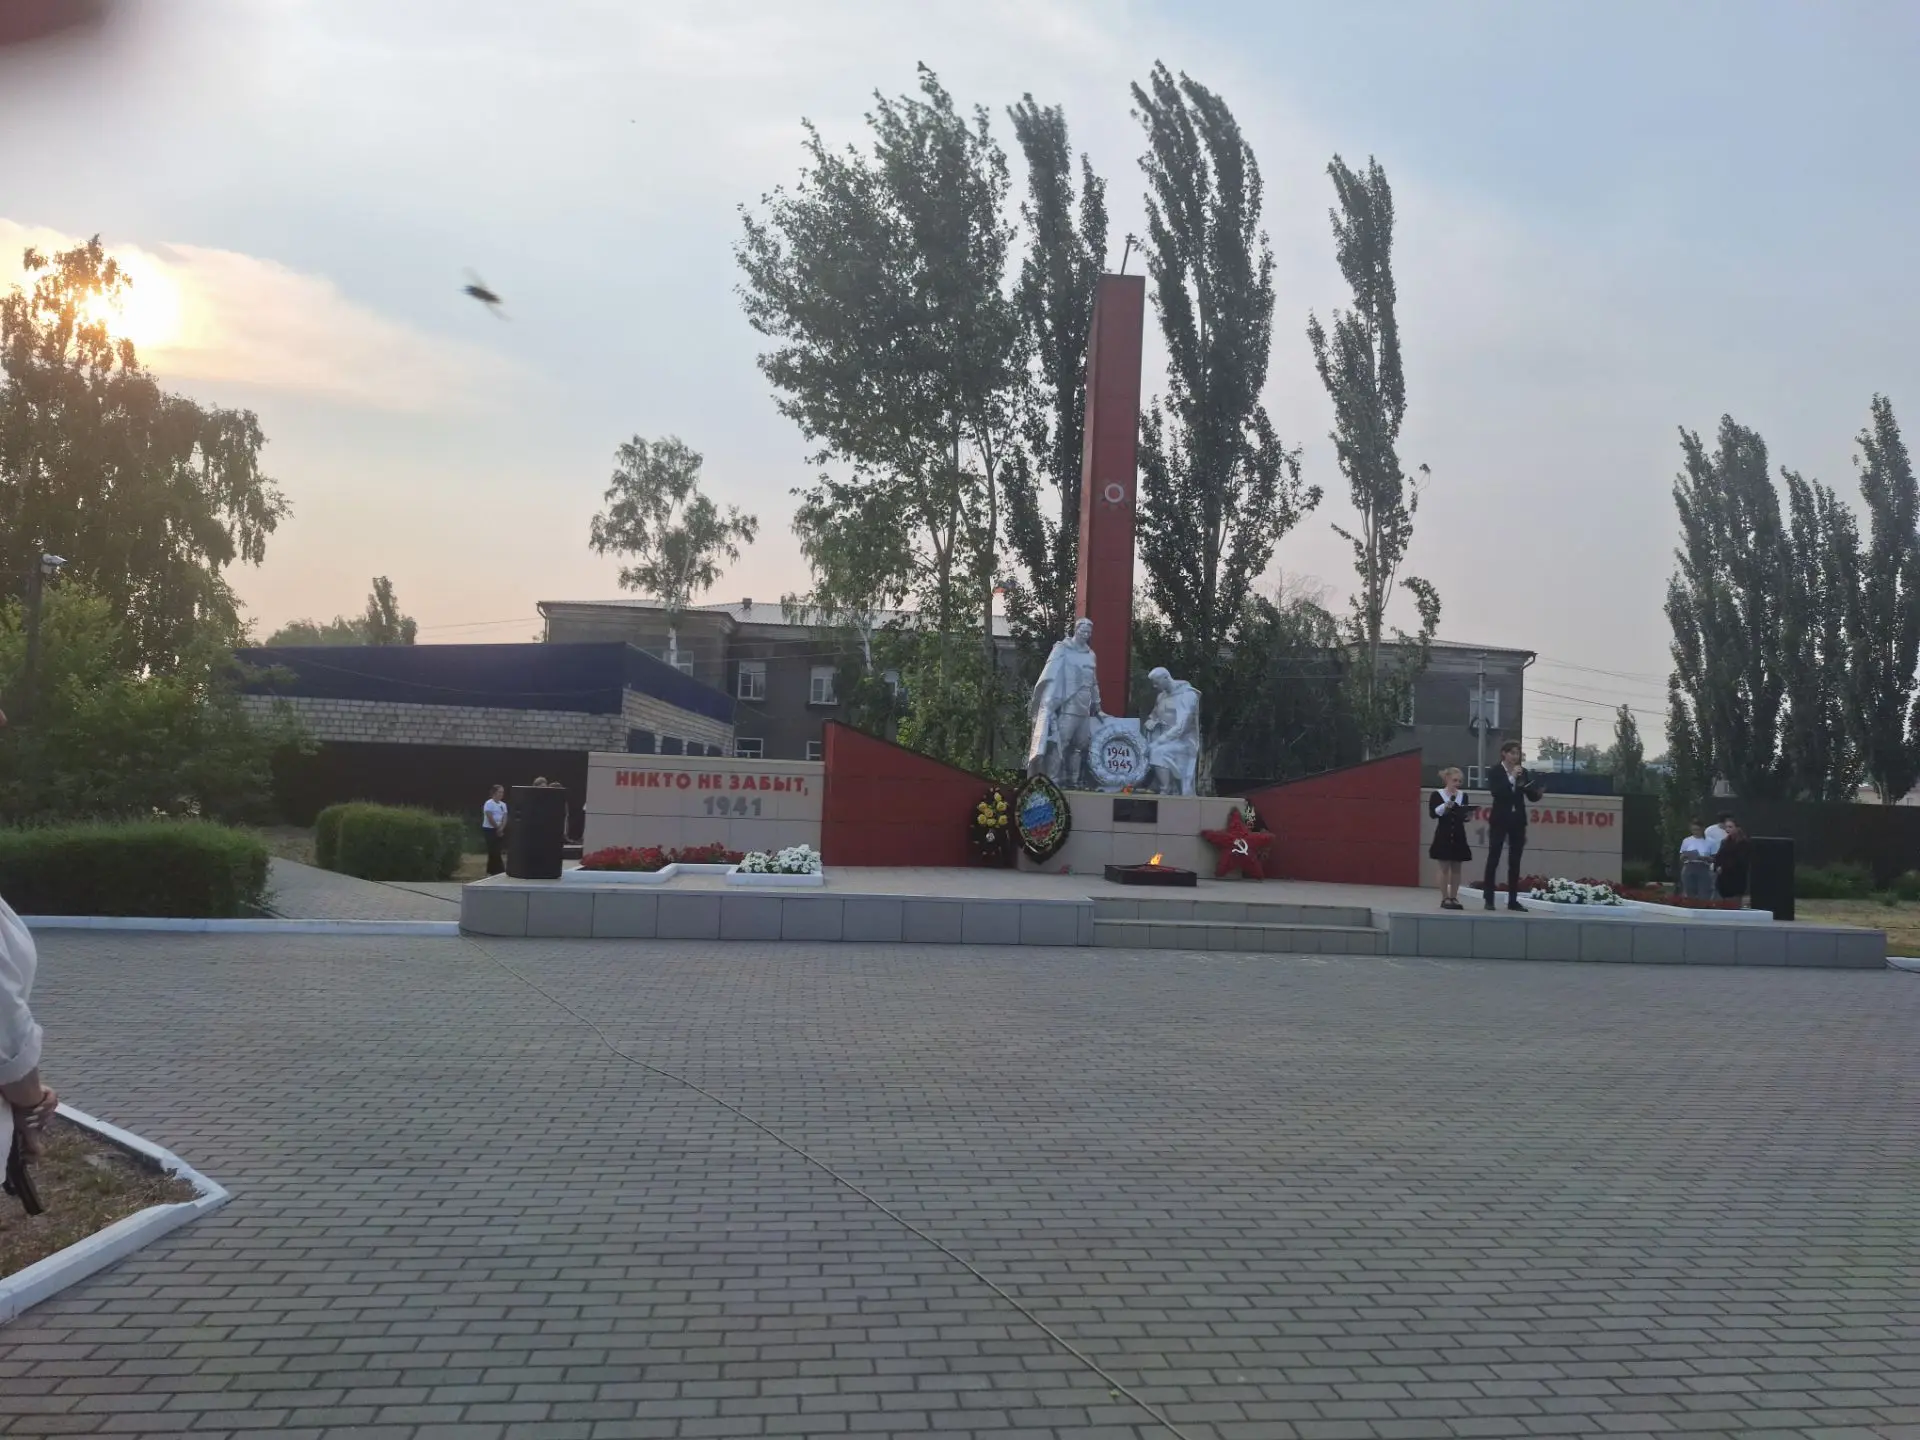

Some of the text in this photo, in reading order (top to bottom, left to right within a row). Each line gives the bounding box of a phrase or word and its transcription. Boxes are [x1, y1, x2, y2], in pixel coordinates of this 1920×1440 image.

[1107, 746, 1130, 759] 1941
[1108, 759, 1133, 773] 1945
[615, 770, 809, 796] НИКТО НЕ ЗАБЫТ,
[703, 796, 762, 816] 1941
[1530, 808, 1615, 829] ЗАБЫТО!
